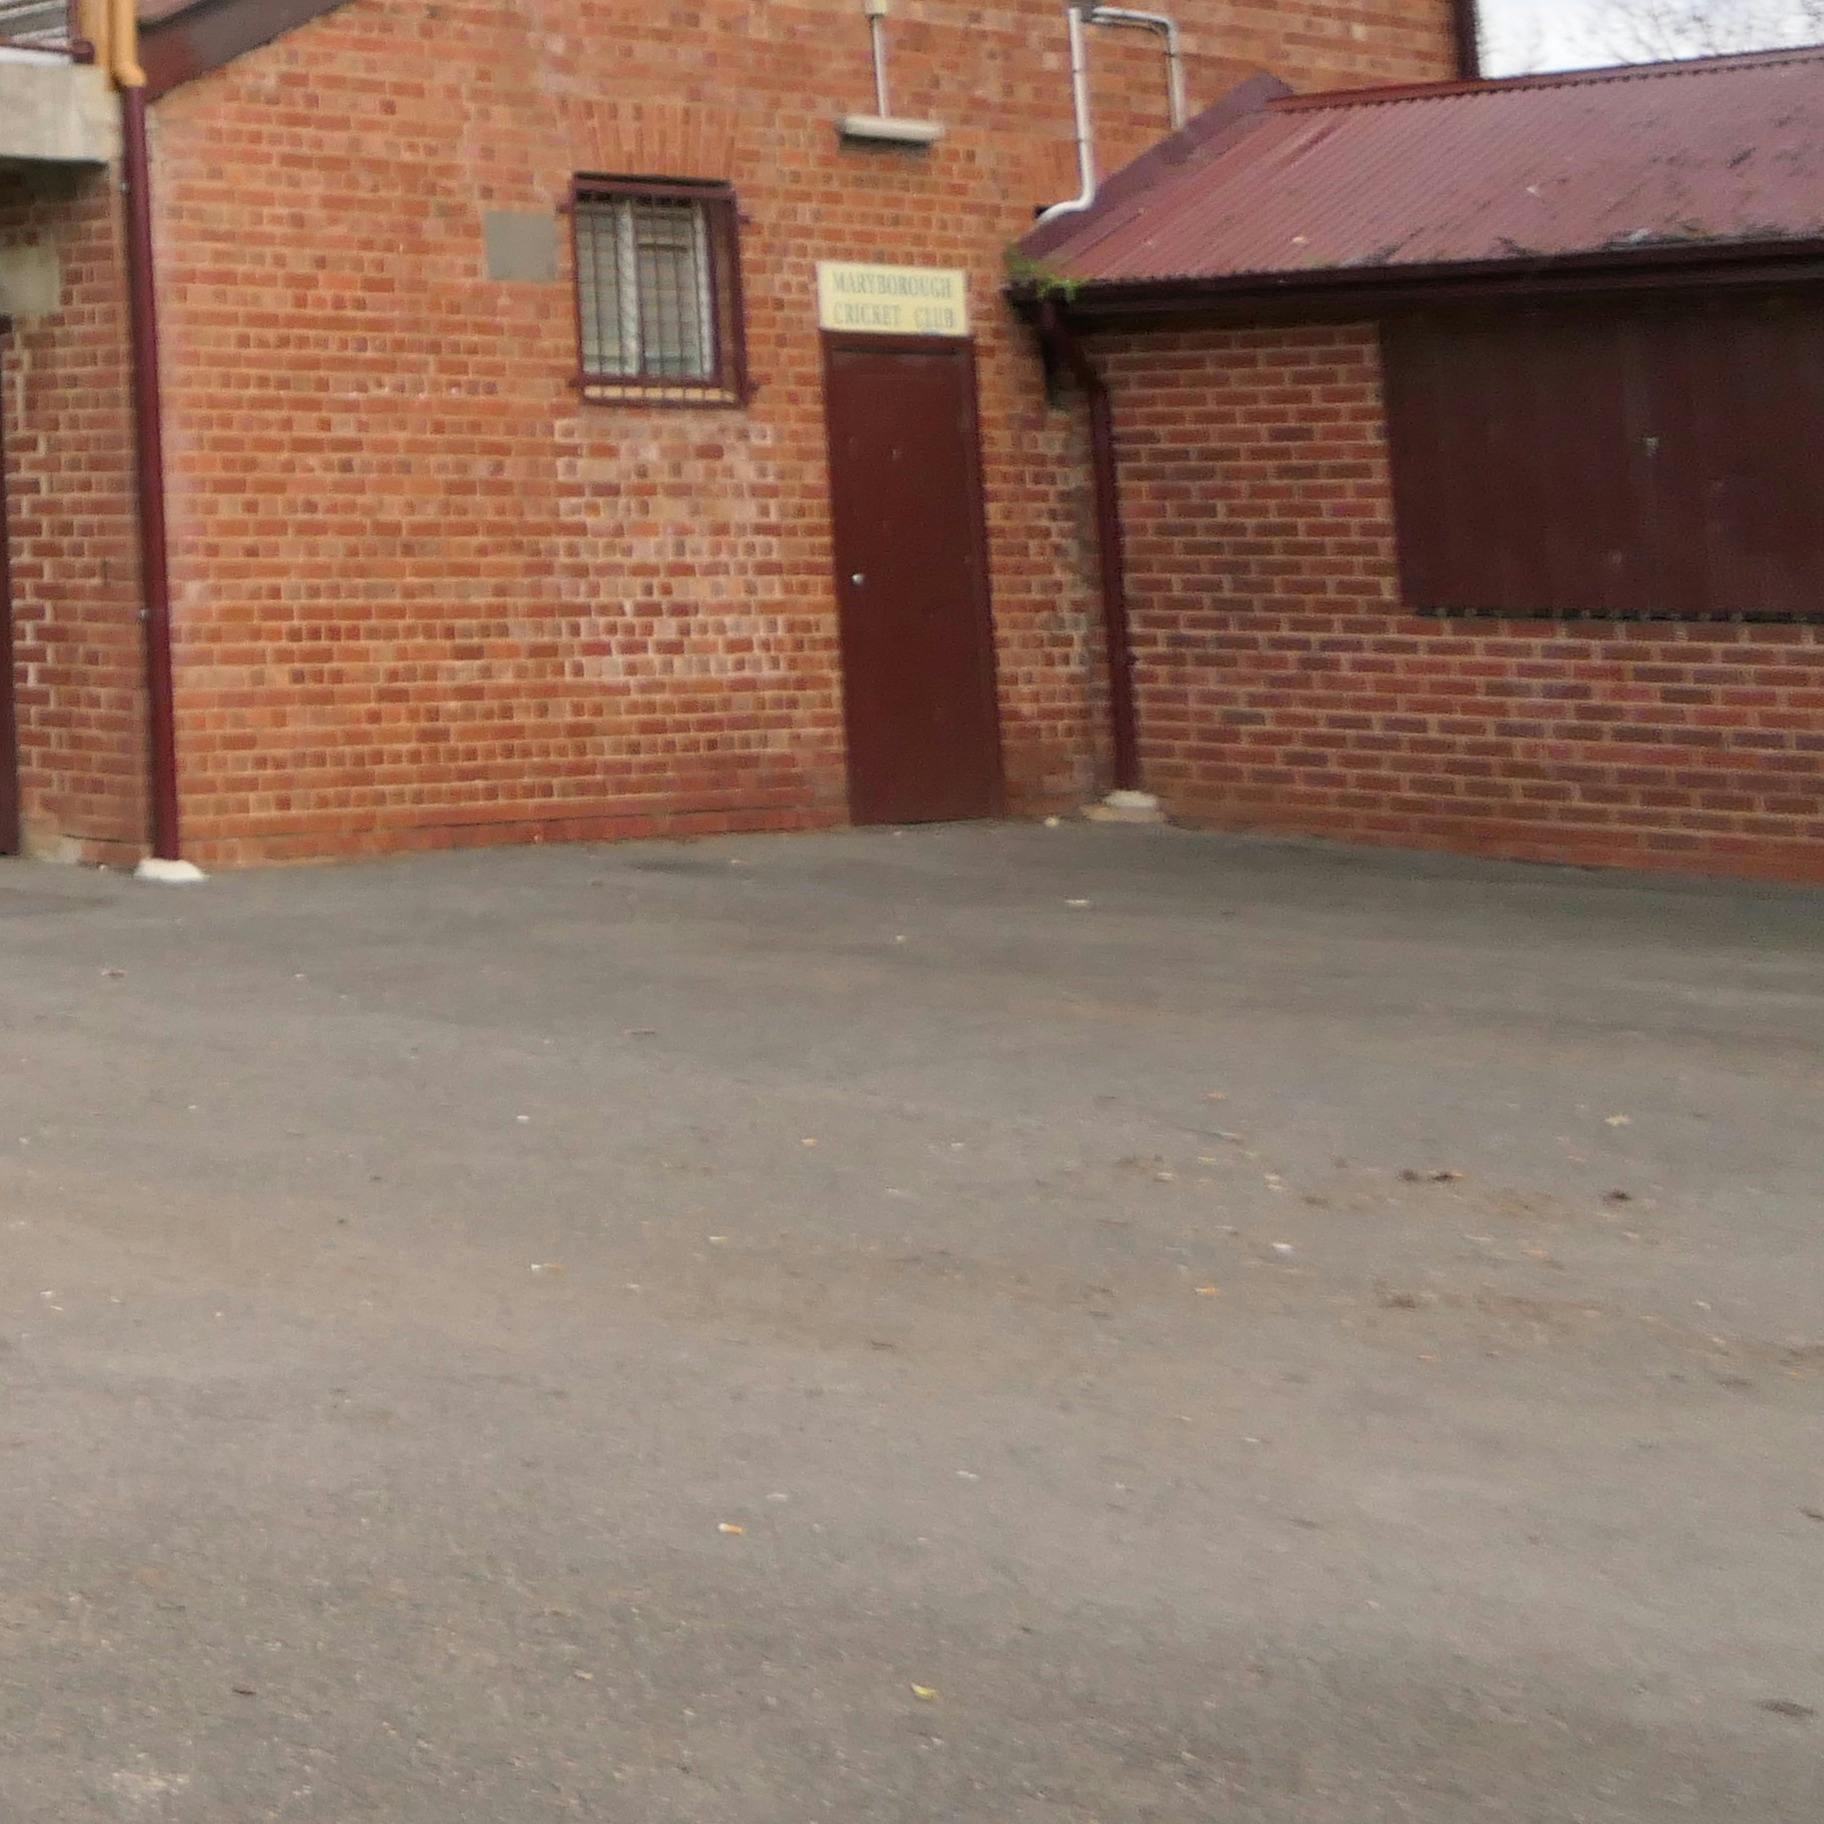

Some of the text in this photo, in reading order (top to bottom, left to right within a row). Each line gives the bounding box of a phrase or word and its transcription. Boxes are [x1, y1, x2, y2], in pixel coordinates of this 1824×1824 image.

[833, 271, 952, 298] MARYBOROUGH
[833, 303, 956, 328] CRICKET CLUB
